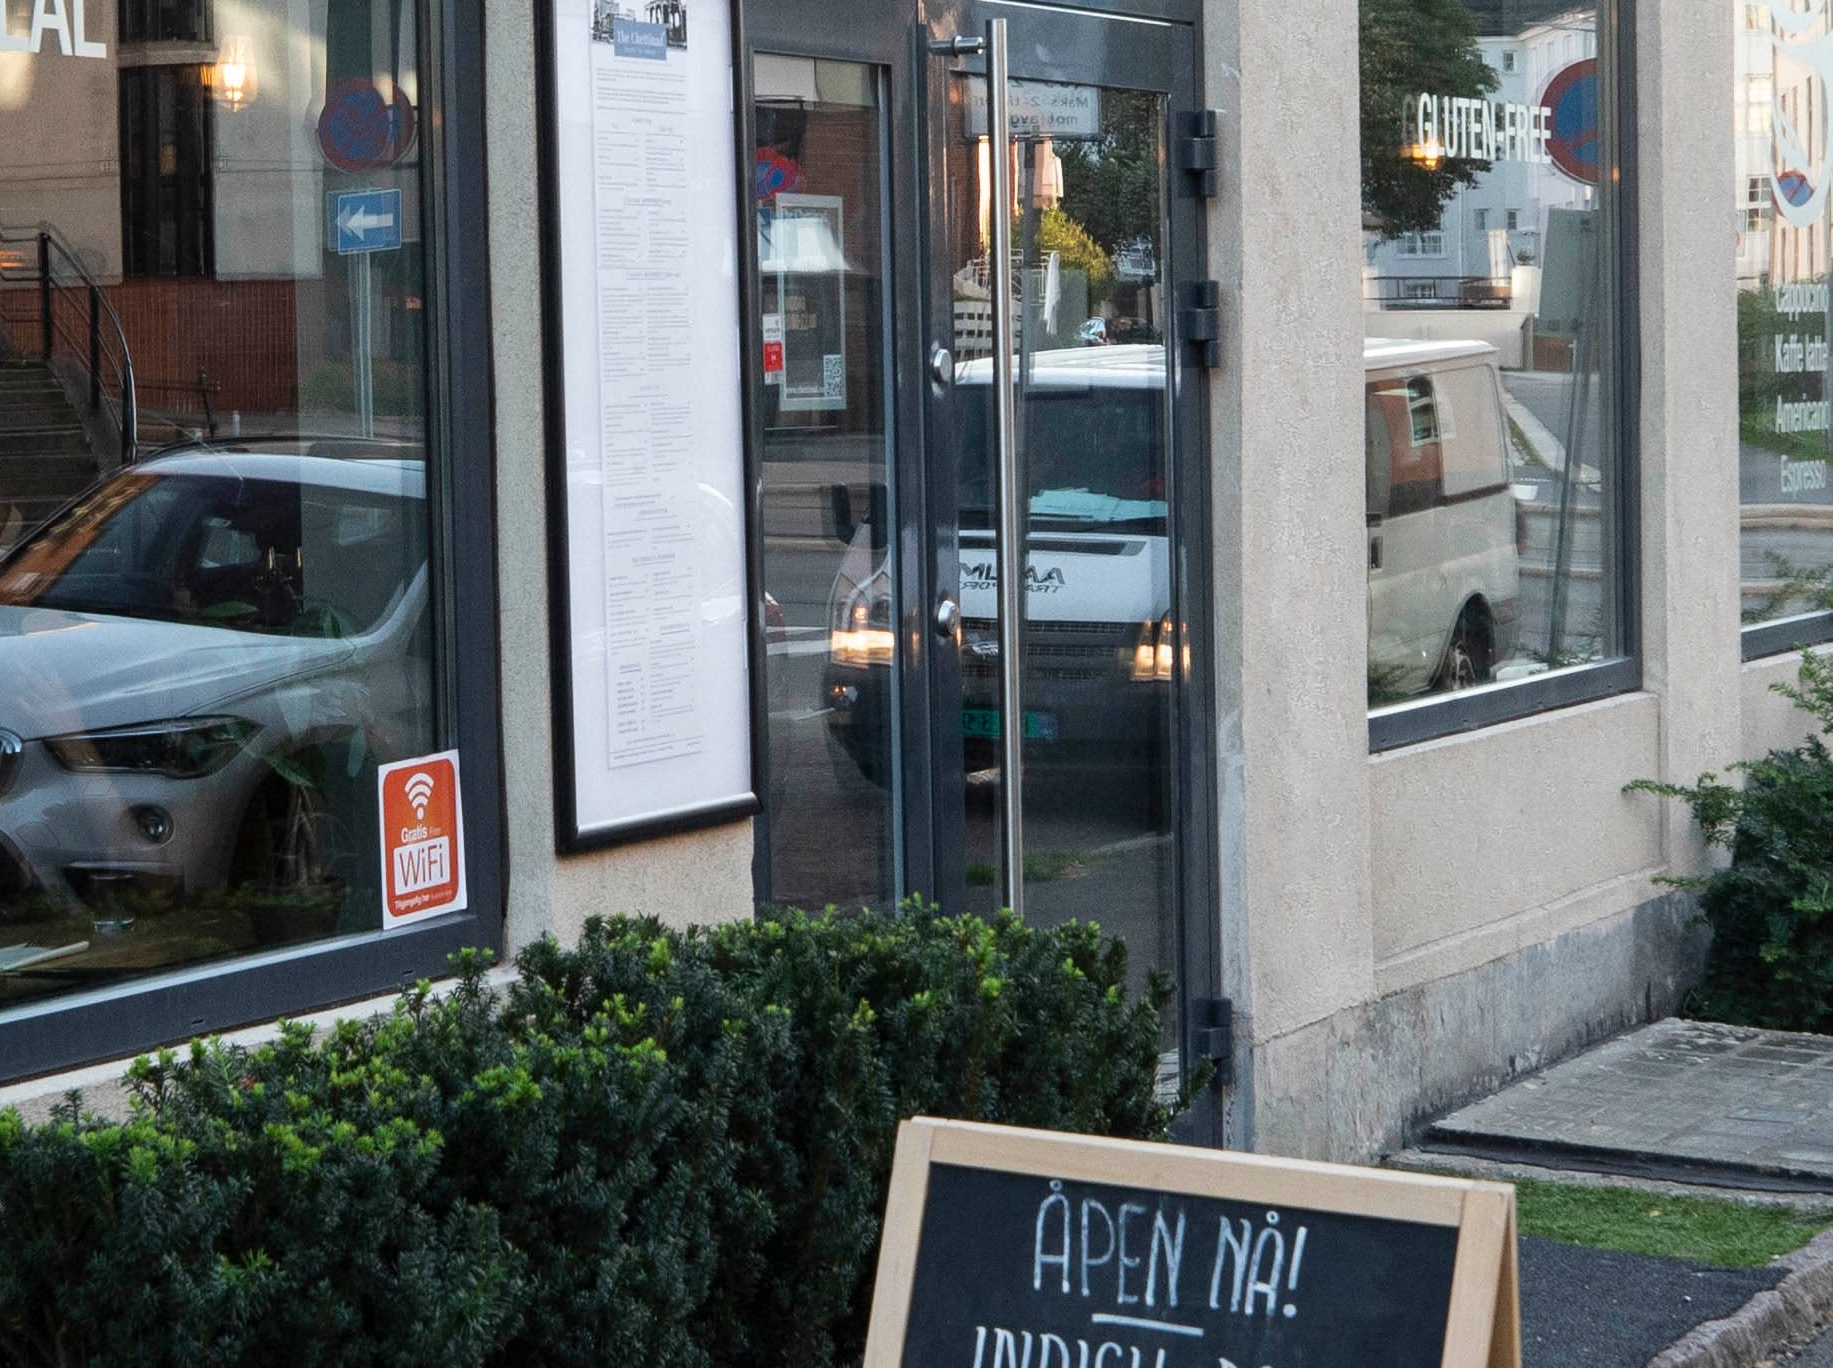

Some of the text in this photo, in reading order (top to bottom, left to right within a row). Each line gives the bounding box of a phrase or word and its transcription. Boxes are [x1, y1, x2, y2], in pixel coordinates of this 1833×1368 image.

[1417, 91, 1553, 164] GLUTEN-FREE
[1774, 333, 1805, 373] Kaffe
[1775, 397, 1831, 433] Americano
[1780, 454, 1827, 501] Espresso
[400, 823, 428, 844] Gratis
[399, 843, 444, 888] WiFi
[1033, 1178, 1309, 1318] ÅPEN NÅ!
